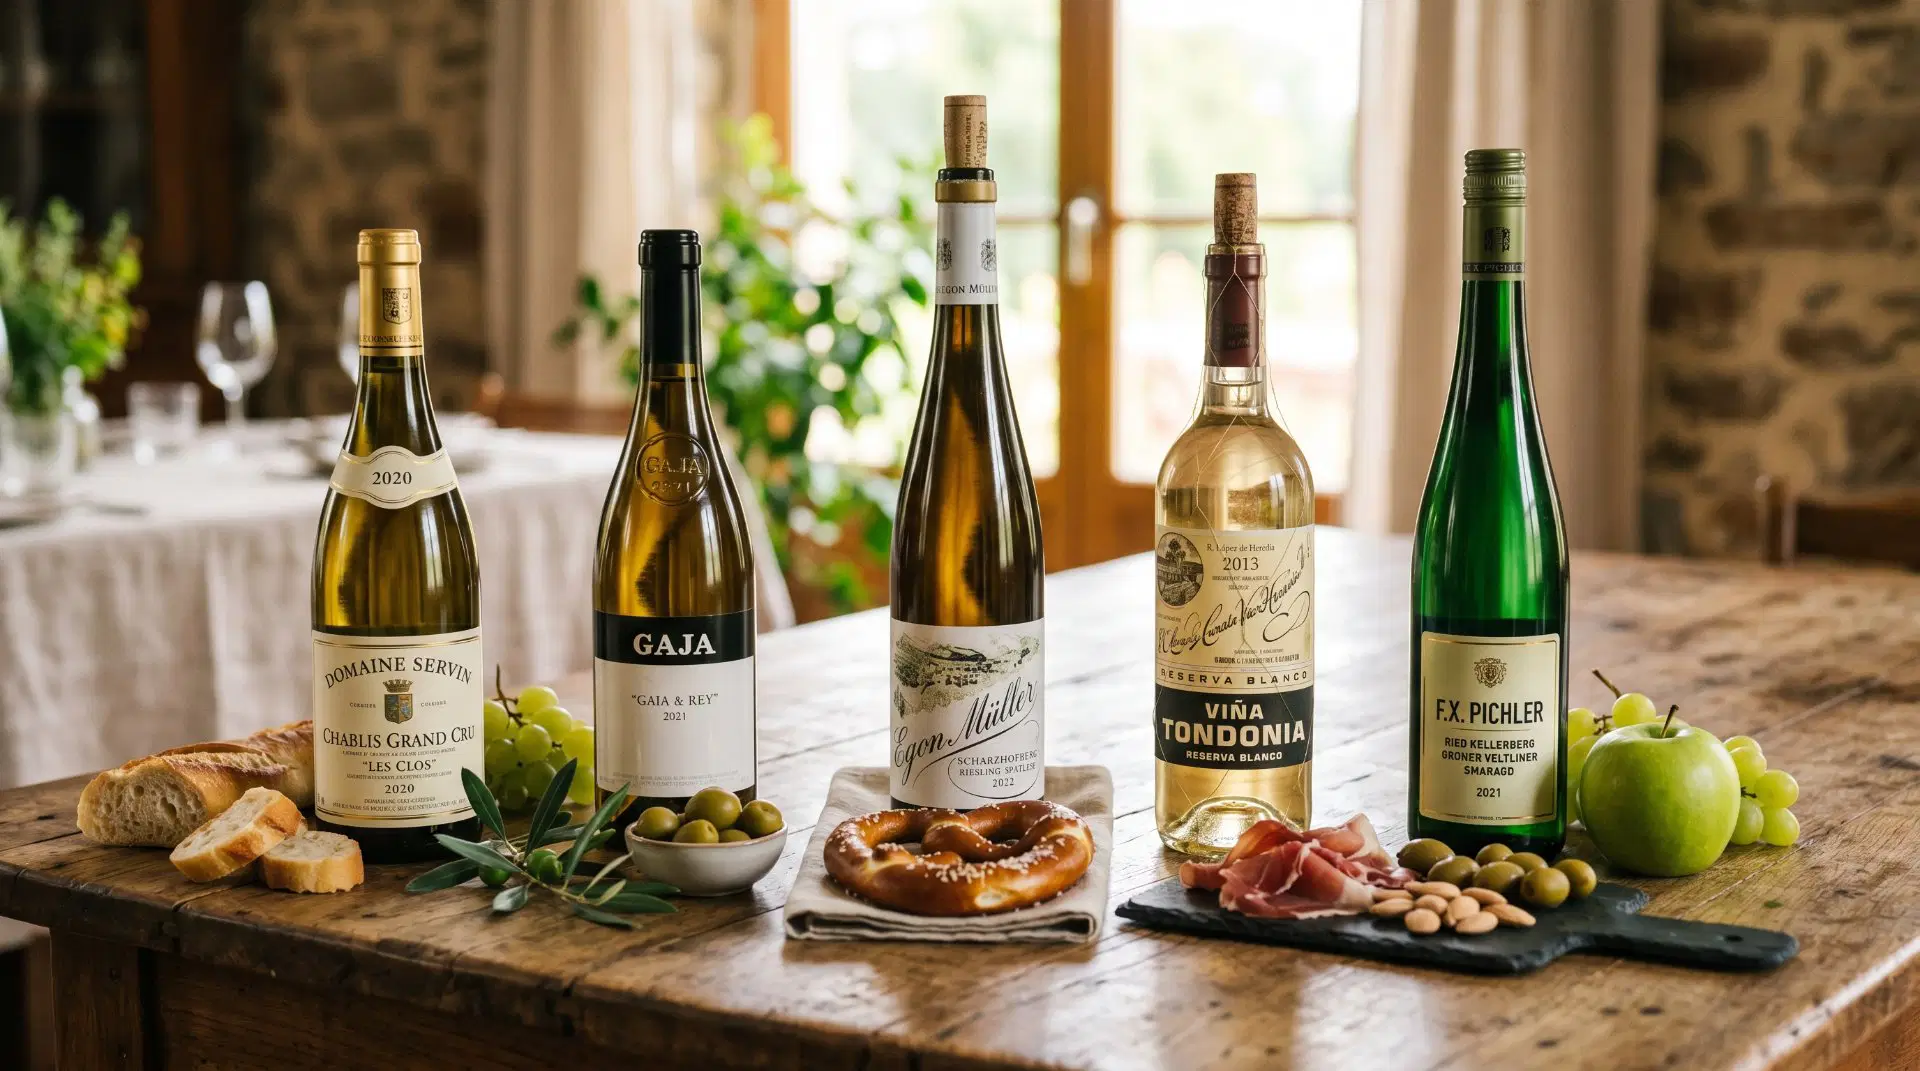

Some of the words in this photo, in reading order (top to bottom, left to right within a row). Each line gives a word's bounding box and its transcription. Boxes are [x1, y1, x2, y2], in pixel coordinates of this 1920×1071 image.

[372, 471, 412, 485] 2020
[1206, 543, 1214, 552] R.
[1240, 544, 1248, 552] de
[1249, 543, 1275, 552] Heredia
[1222, 556, 1259, 571] 2013
[633, 633, 716, 656] GAJA
[324, 657, 406, 689] DOMAINE
[412, 656, 472, 685] SERVIN
[1161, 668, 1233, 685] RESERVA
[1247, 670, 1308, 685] BLANCO
[674, 696, 684, 706] &
[663, 711, 687, 721] 2021
[1205, 699, 1264, 720] VIÑA
[1436, 698, 1465, 723] F.X.
[1470, 700, 1544, 725] PICHLER
[323, 727, 381, 748] CHABLIS
[386, 732, 447, 748] GRAND
[451, 725, 475, 743] CRU
[894, 726, 948, 785] Egon
[948, 676, 1037, 746] Müller
[1162, 717, 1306, 747] TONDONIA
[1444, 737, 1467, 748] RIED
[1470, 739, 1535, 750] KELLERBERG
[957, 750, 1038, 766] SCHARZHOFBERG
[1186, 750, 1236, 762] RESERVA
[1239, 751, 1283, 762] BLANCO
[1485, 752, 1538, 763] VELTLINER
[959, 767, 1001, 777] RIESLING
[1464, 765, 1514, 776] SMARAGD
[384, 783, 415, 794] 2020
[992, 777, 1015, 788] 2022
[1476, 787, 1501, 798] 2021
